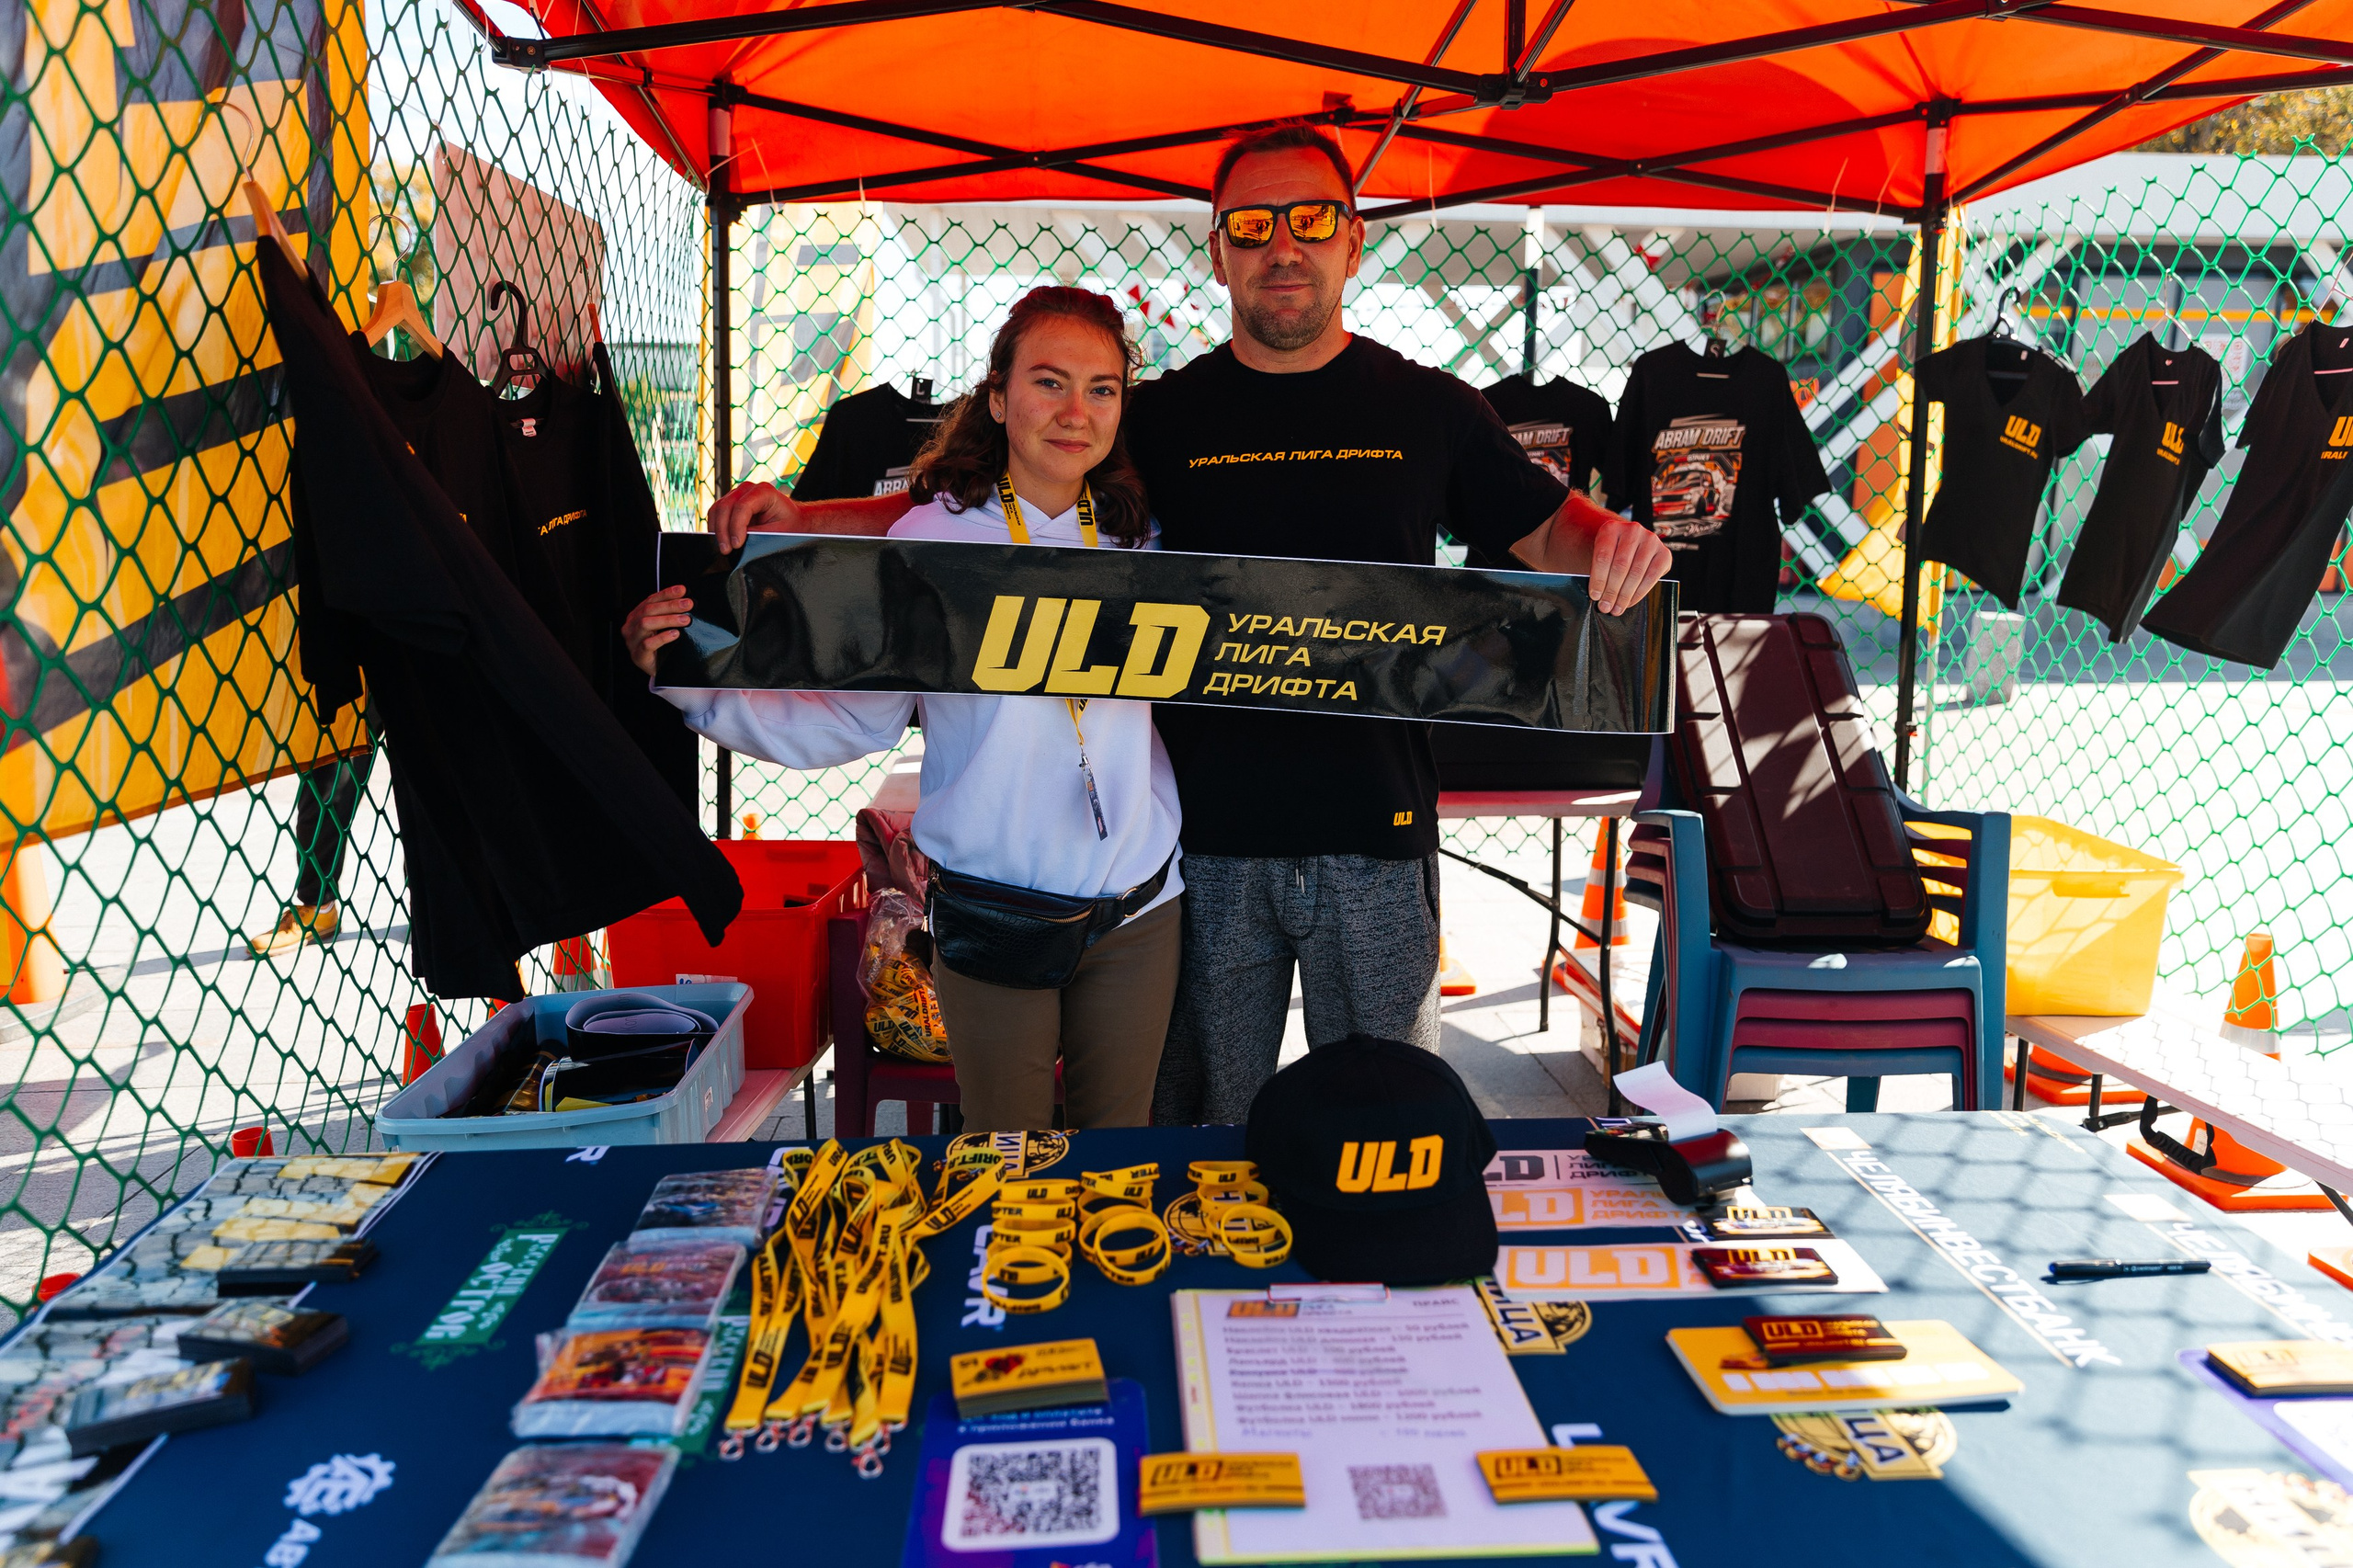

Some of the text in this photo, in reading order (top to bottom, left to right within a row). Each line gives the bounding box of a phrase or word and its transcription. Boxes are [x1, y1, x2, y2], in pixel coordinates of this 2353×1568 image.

[1536, 427, 1571, 445] DRIFT
[1654, 426, 1745, 450] ABRAM DRIFT
[2005, 415, 2042, 449] ULD
[1189, 448, 1404, 469] УРАЛЬСКАЯ ЛИГА ДРИФТА
[873, 478, 910, 496] ABRA
[996, 476, 1016, 504] ULD
[1077, 499, 1095, 527] ULD
[1228, 613, 1448, 646] УРАЛЬСКАЯ
[971, 595, 1211, 698] ULD
[1214, 642, 1312, 667] ЛИГА
[1203, 672, 1358, 701] ДРИФТА
[1392, 810, 1413, 826] ULD
[1336, 1134, 1444, 1193] ULD
[1219, 1173, 1236, 1183] ULD
[1027, 1188, 1048, 1199] ULD
[1124, 1186, 1143, 1198] ULD
[1591, 1199, 1660, 1208] ЛИГА
[790, 1196, 811, 1234] ULD
[925, 1206, 957, 1231] ULD
[1591, 1210, 1699, 1221] ДРИФТА
[840, 1221, 863, 1255] ULD
[1516, 1249, 1671, 1283] ULD
[1843, 1150, 2124, 1368] ЧЕЛЯБИНВЕСТБАНК
[1768, 1324, 1819, 1336] ULD
[746, 1350, 774, 1388] ULD
[1842, 1412, 1906, 1463] ЦА
